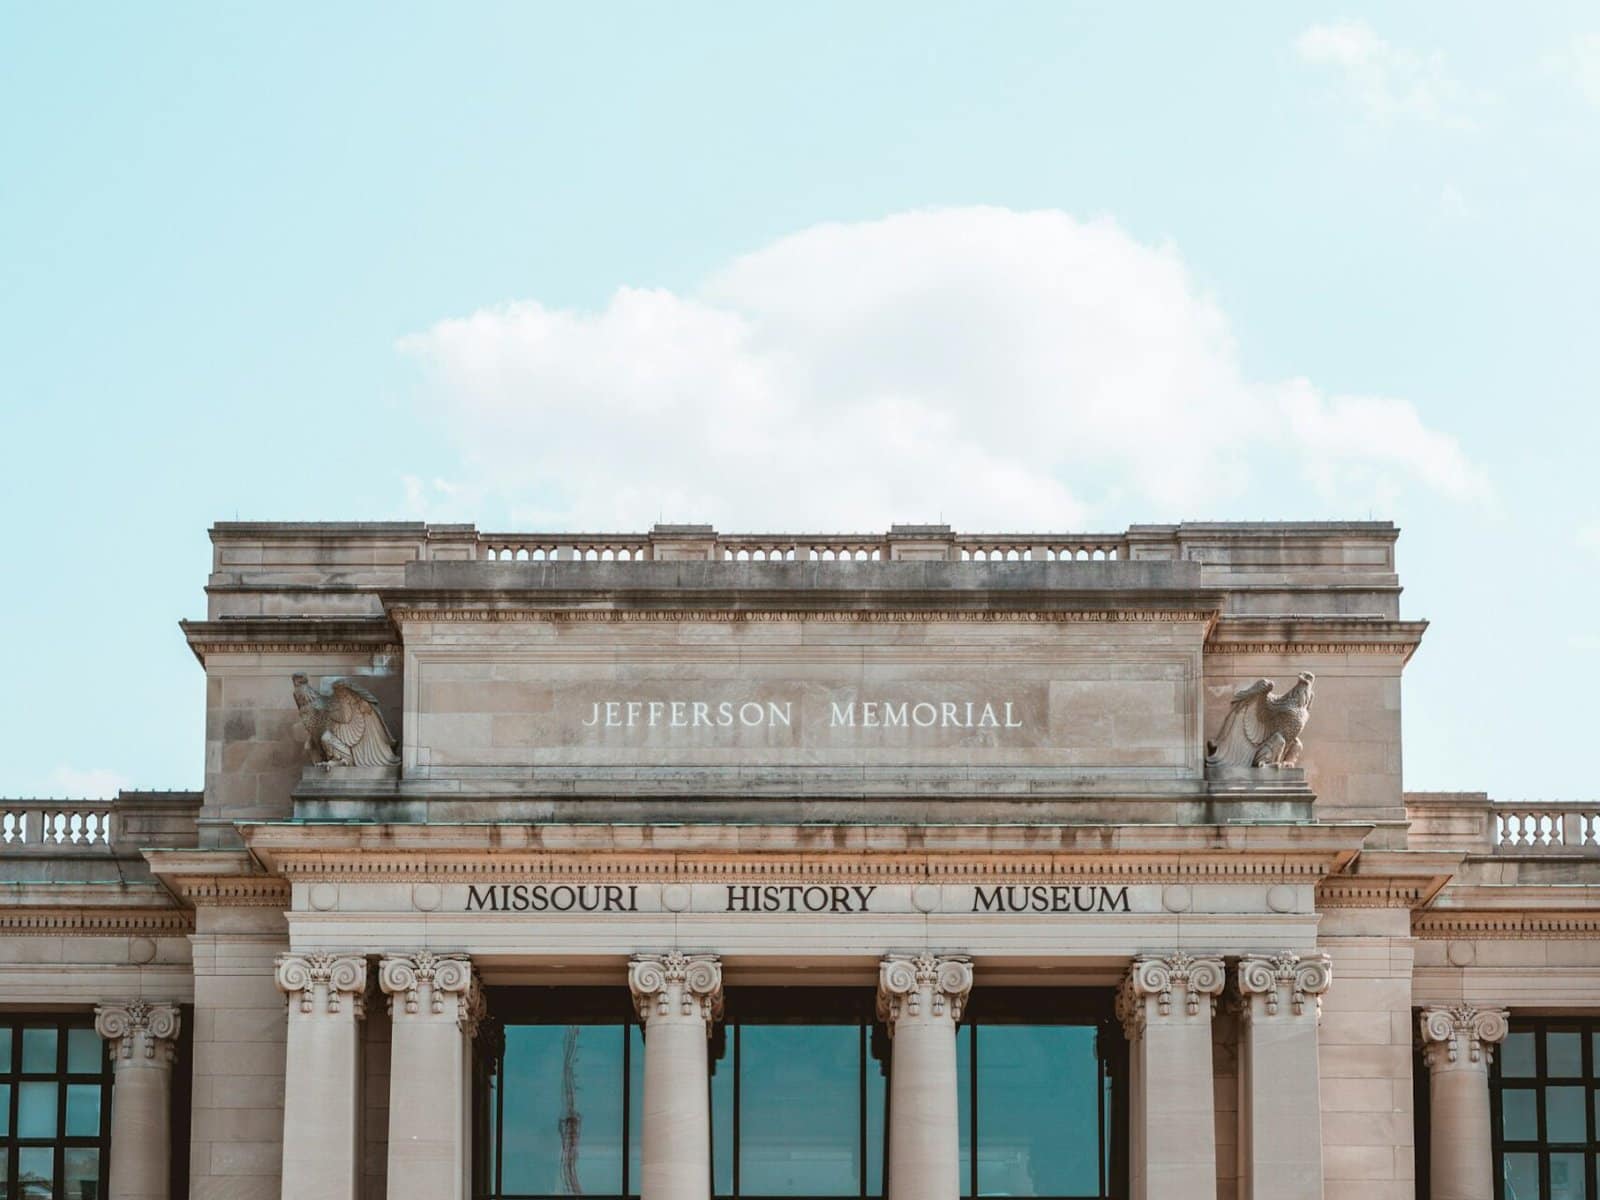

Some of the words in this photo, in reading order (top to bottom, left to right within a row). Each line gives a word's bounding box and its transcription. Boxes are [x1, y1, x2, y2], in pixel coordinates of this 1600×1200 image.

[582, 702, 792, 727] JEFFERSON
[830, 702, 1023, 727] MEMORIAL
[465, 885, 638, 911] MISSOURI
[726, 885, 877, 912] HISTORY
[971, 886, 1131, 912] MUSEUM
